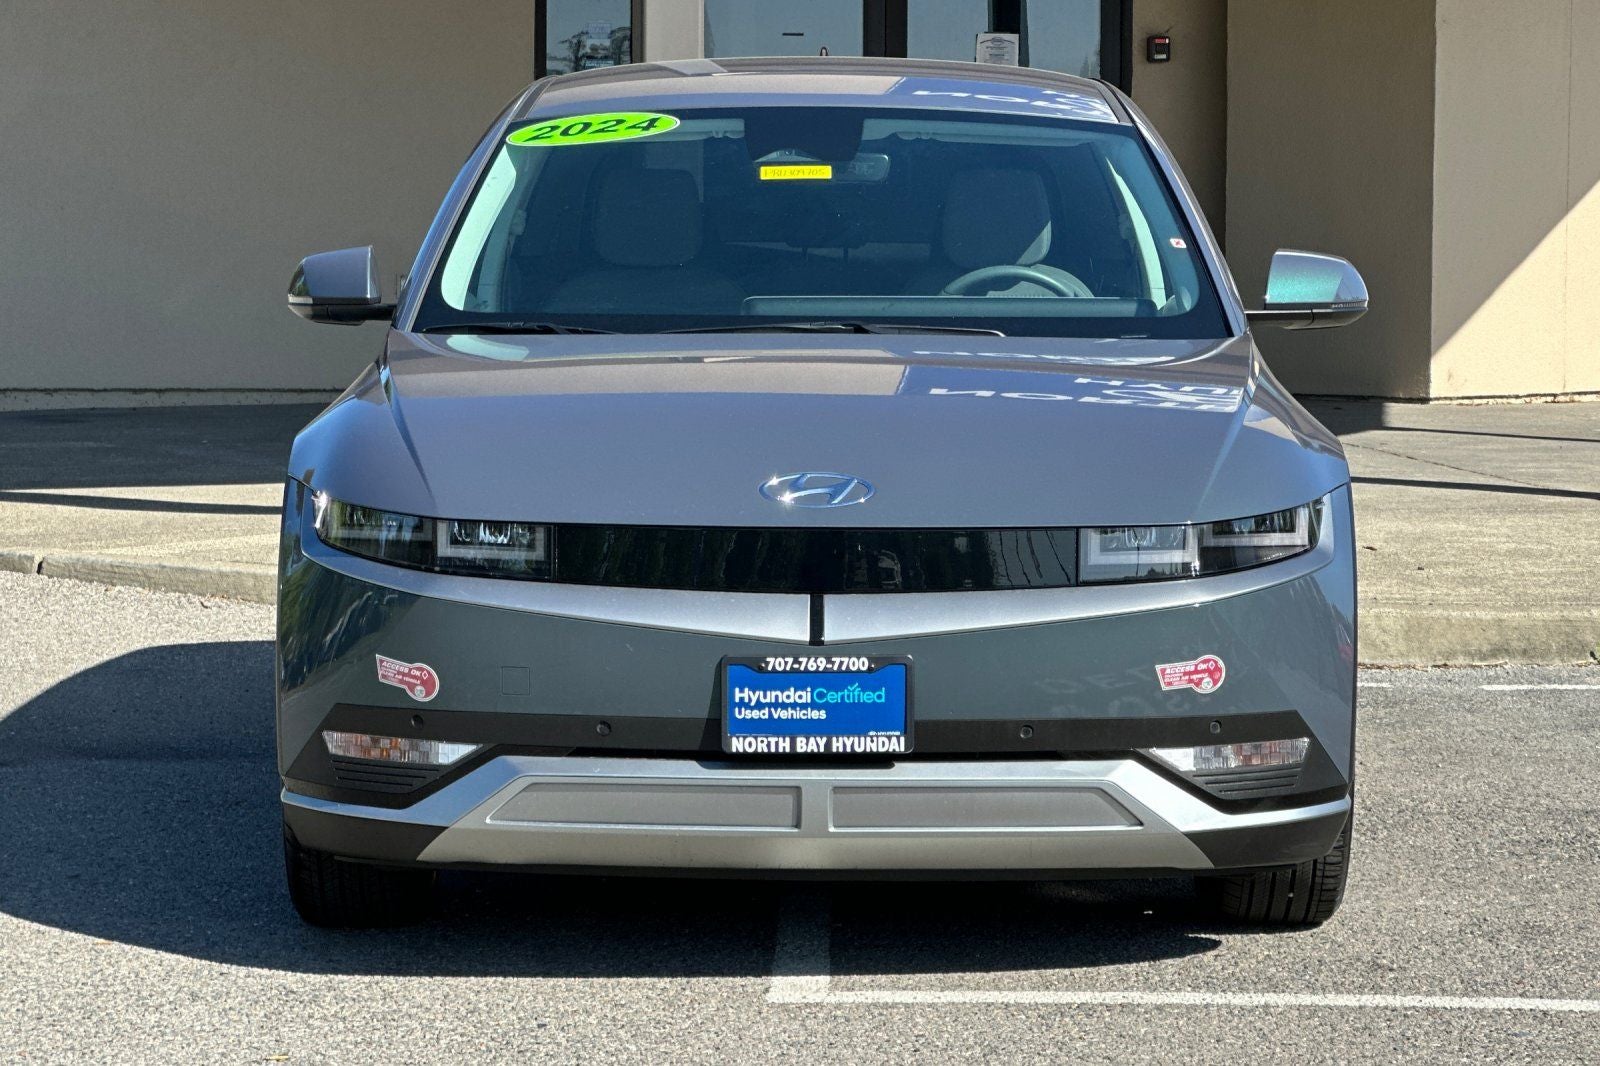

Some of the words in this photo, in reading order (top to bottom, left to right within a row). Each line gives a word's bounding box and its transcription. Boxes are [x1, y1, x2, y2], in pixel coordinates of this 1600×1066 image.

[523, 117, 660, 142] 2024
[381, 661, 410, 673] ACCESS
[766, 657, 869, 671] 707-769-7700
[1165, 665, 1195, 674] ACCESS
[734, 686, 811, 706] Hyundai
[813, 682, 886, 703] Certified
[734, 706, 769, 719] Used
[770, 706, 827, 720] Vehicles
[731, 736, 791, 753] NORTH
[796, 736, 828, 753] BAY
[832, 736, 905, 753] HYUNDAI
